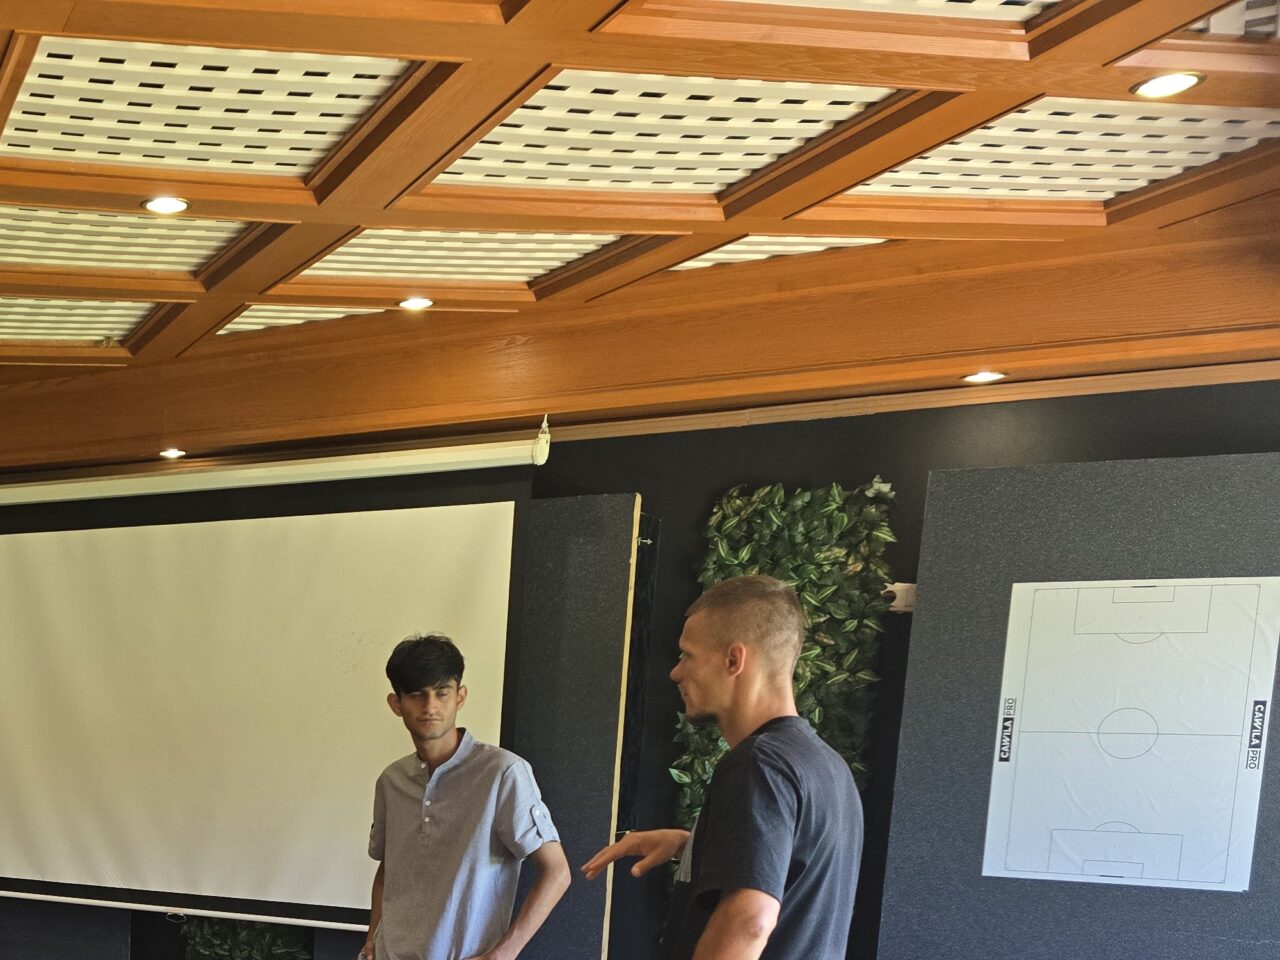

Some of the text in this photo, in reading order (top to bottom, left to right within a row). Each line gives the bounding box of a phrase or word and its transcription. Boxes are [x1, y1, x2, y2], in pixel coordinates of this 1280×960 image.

[1000, 697, 1015, 759] CAWILA PRO
[1248, 704, 1264, 770] CAWILA PRO
